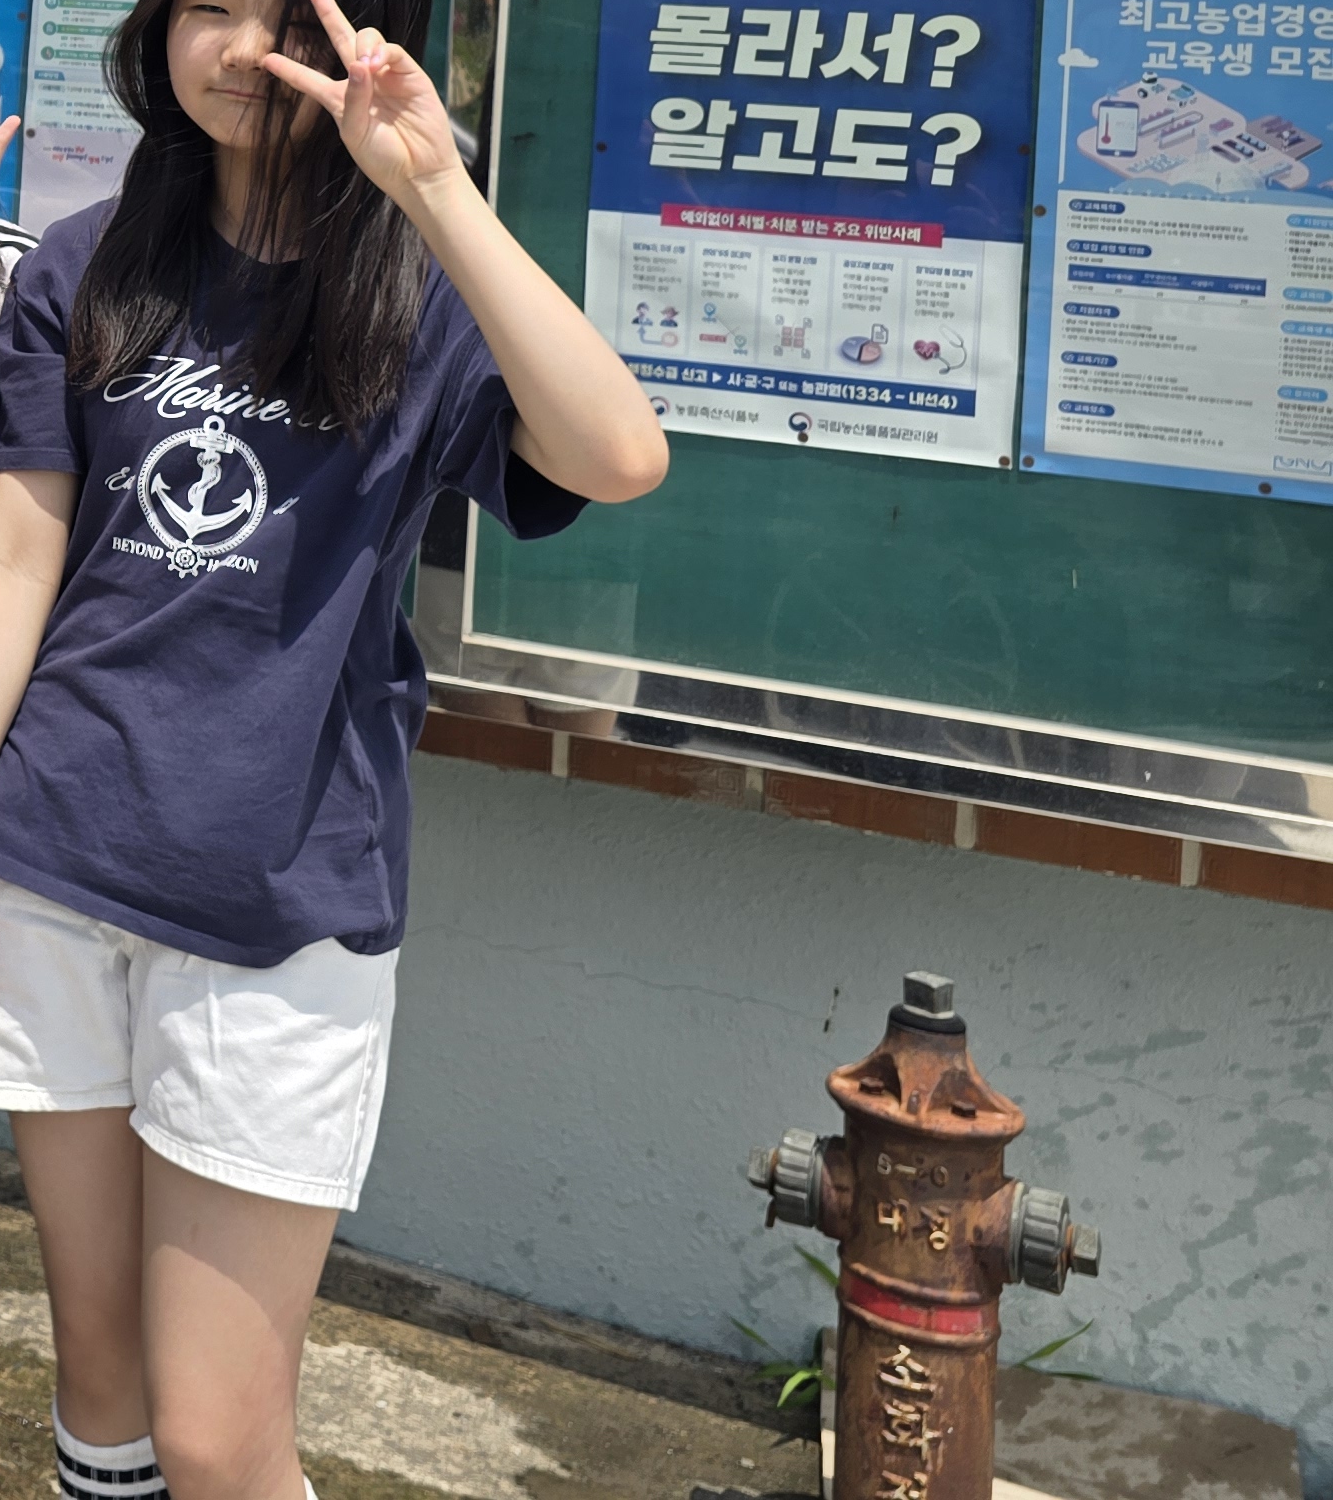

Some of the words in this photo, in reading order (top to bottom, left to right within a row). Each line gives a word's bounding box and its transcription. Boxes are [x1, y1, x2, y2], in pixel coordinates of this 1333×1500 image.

[649, 3, 982, 89] 몰라서?
[1142, 40, 1254, 77] 교육생
[649, 96, 983, 187] 알고도?
[832, 221, 861, 238] 주요
[864, 225, 922, 243] 위반사례
[112, 536, 165, 561] BEYOND
